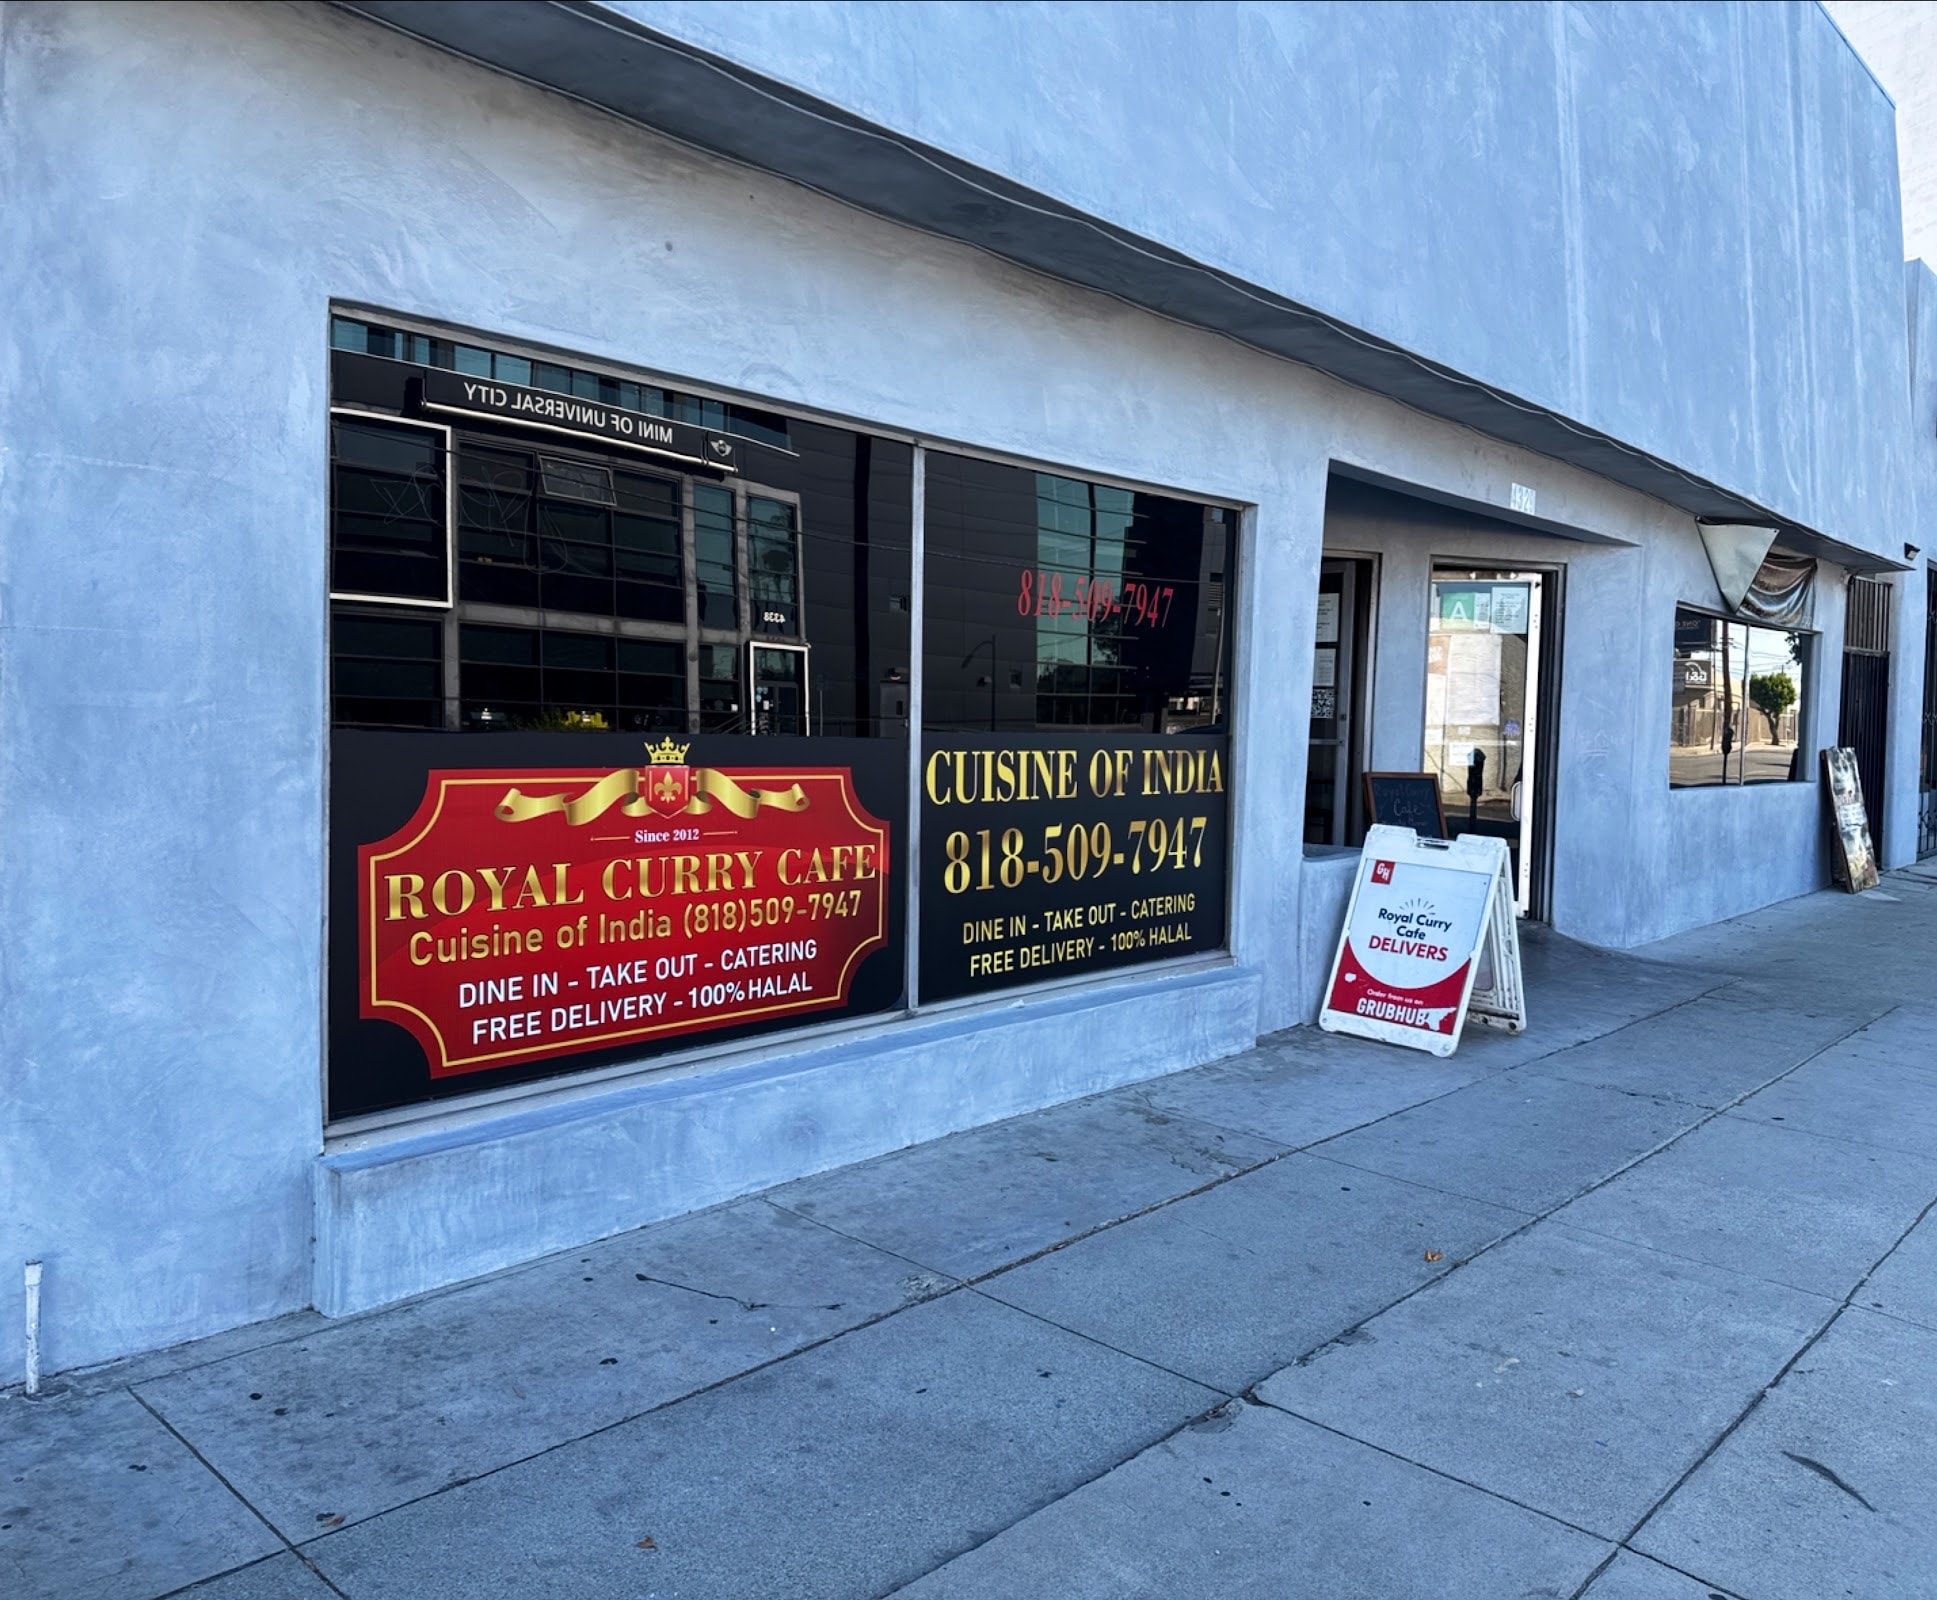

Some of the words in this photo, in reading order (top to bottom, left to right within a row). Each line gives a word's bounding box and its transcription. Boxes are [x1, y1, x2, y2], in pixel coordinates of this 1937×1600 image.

[1018, 569, 1174, 629] 818-509-7947
[1450, 600, 1468, 621] A
[926, 749, 1078, 805] CUISINE
[1089, 749, 1134, 798] OF
[1142, 749, 1224, 796] INDIA
[634, 829, 670, 844] Since
[672, 828, 700, 843] 2012
[943, 816, 1207, 894] 818-509-7947
[384, 862, 584, 922] ROYAL
[601, 850, 763, 900] CURRY
[776, 844, 877, 885] CAFE
[408, 924, 543, 966] Cuisine
[556, 915, 588, 947] of
[599, 909, 671, 944] India
[684, 889, 862, 940] (818)509-7947
[963, 919, 1004, 944] DINE
[1009, 915, 1027, 936] IN
[1044, 908, 1083, 933] TAKE
[1088, 903, 1116, 924] OUT
[1131, 893, 1196, 920] CATERING
[1378, 908, 1413, 924] Royal
[1416, 914, 1452, 932] Curry
[1396, 926, 1426, 940] Cafe
[459, 978, 524, 1008] DINE
[533, 972, 559, 996] IN
[586, 960, 647, 988] TAKE
[654, 954, 698, 981] OUT
[720, 939, 817, 971] CATERING
[969, 950, 1014, 977] FREE
[1019, 936, 1095, 969] DELIVERY
[1110, 930, 1146, 952] 100%
[1149, 922, 1192, 945] HALAL
[1368, 935, 1448, 962] DELIVERS
[472, 1012, 541, 1045] FREE
[551, 993, 666, 1030] DELIVERY
[748, 971, 812, 1000] HALAL
[1356, 997, 1426, 1026] GRUBHUB
[1367, 988, 1386, 998] Order
